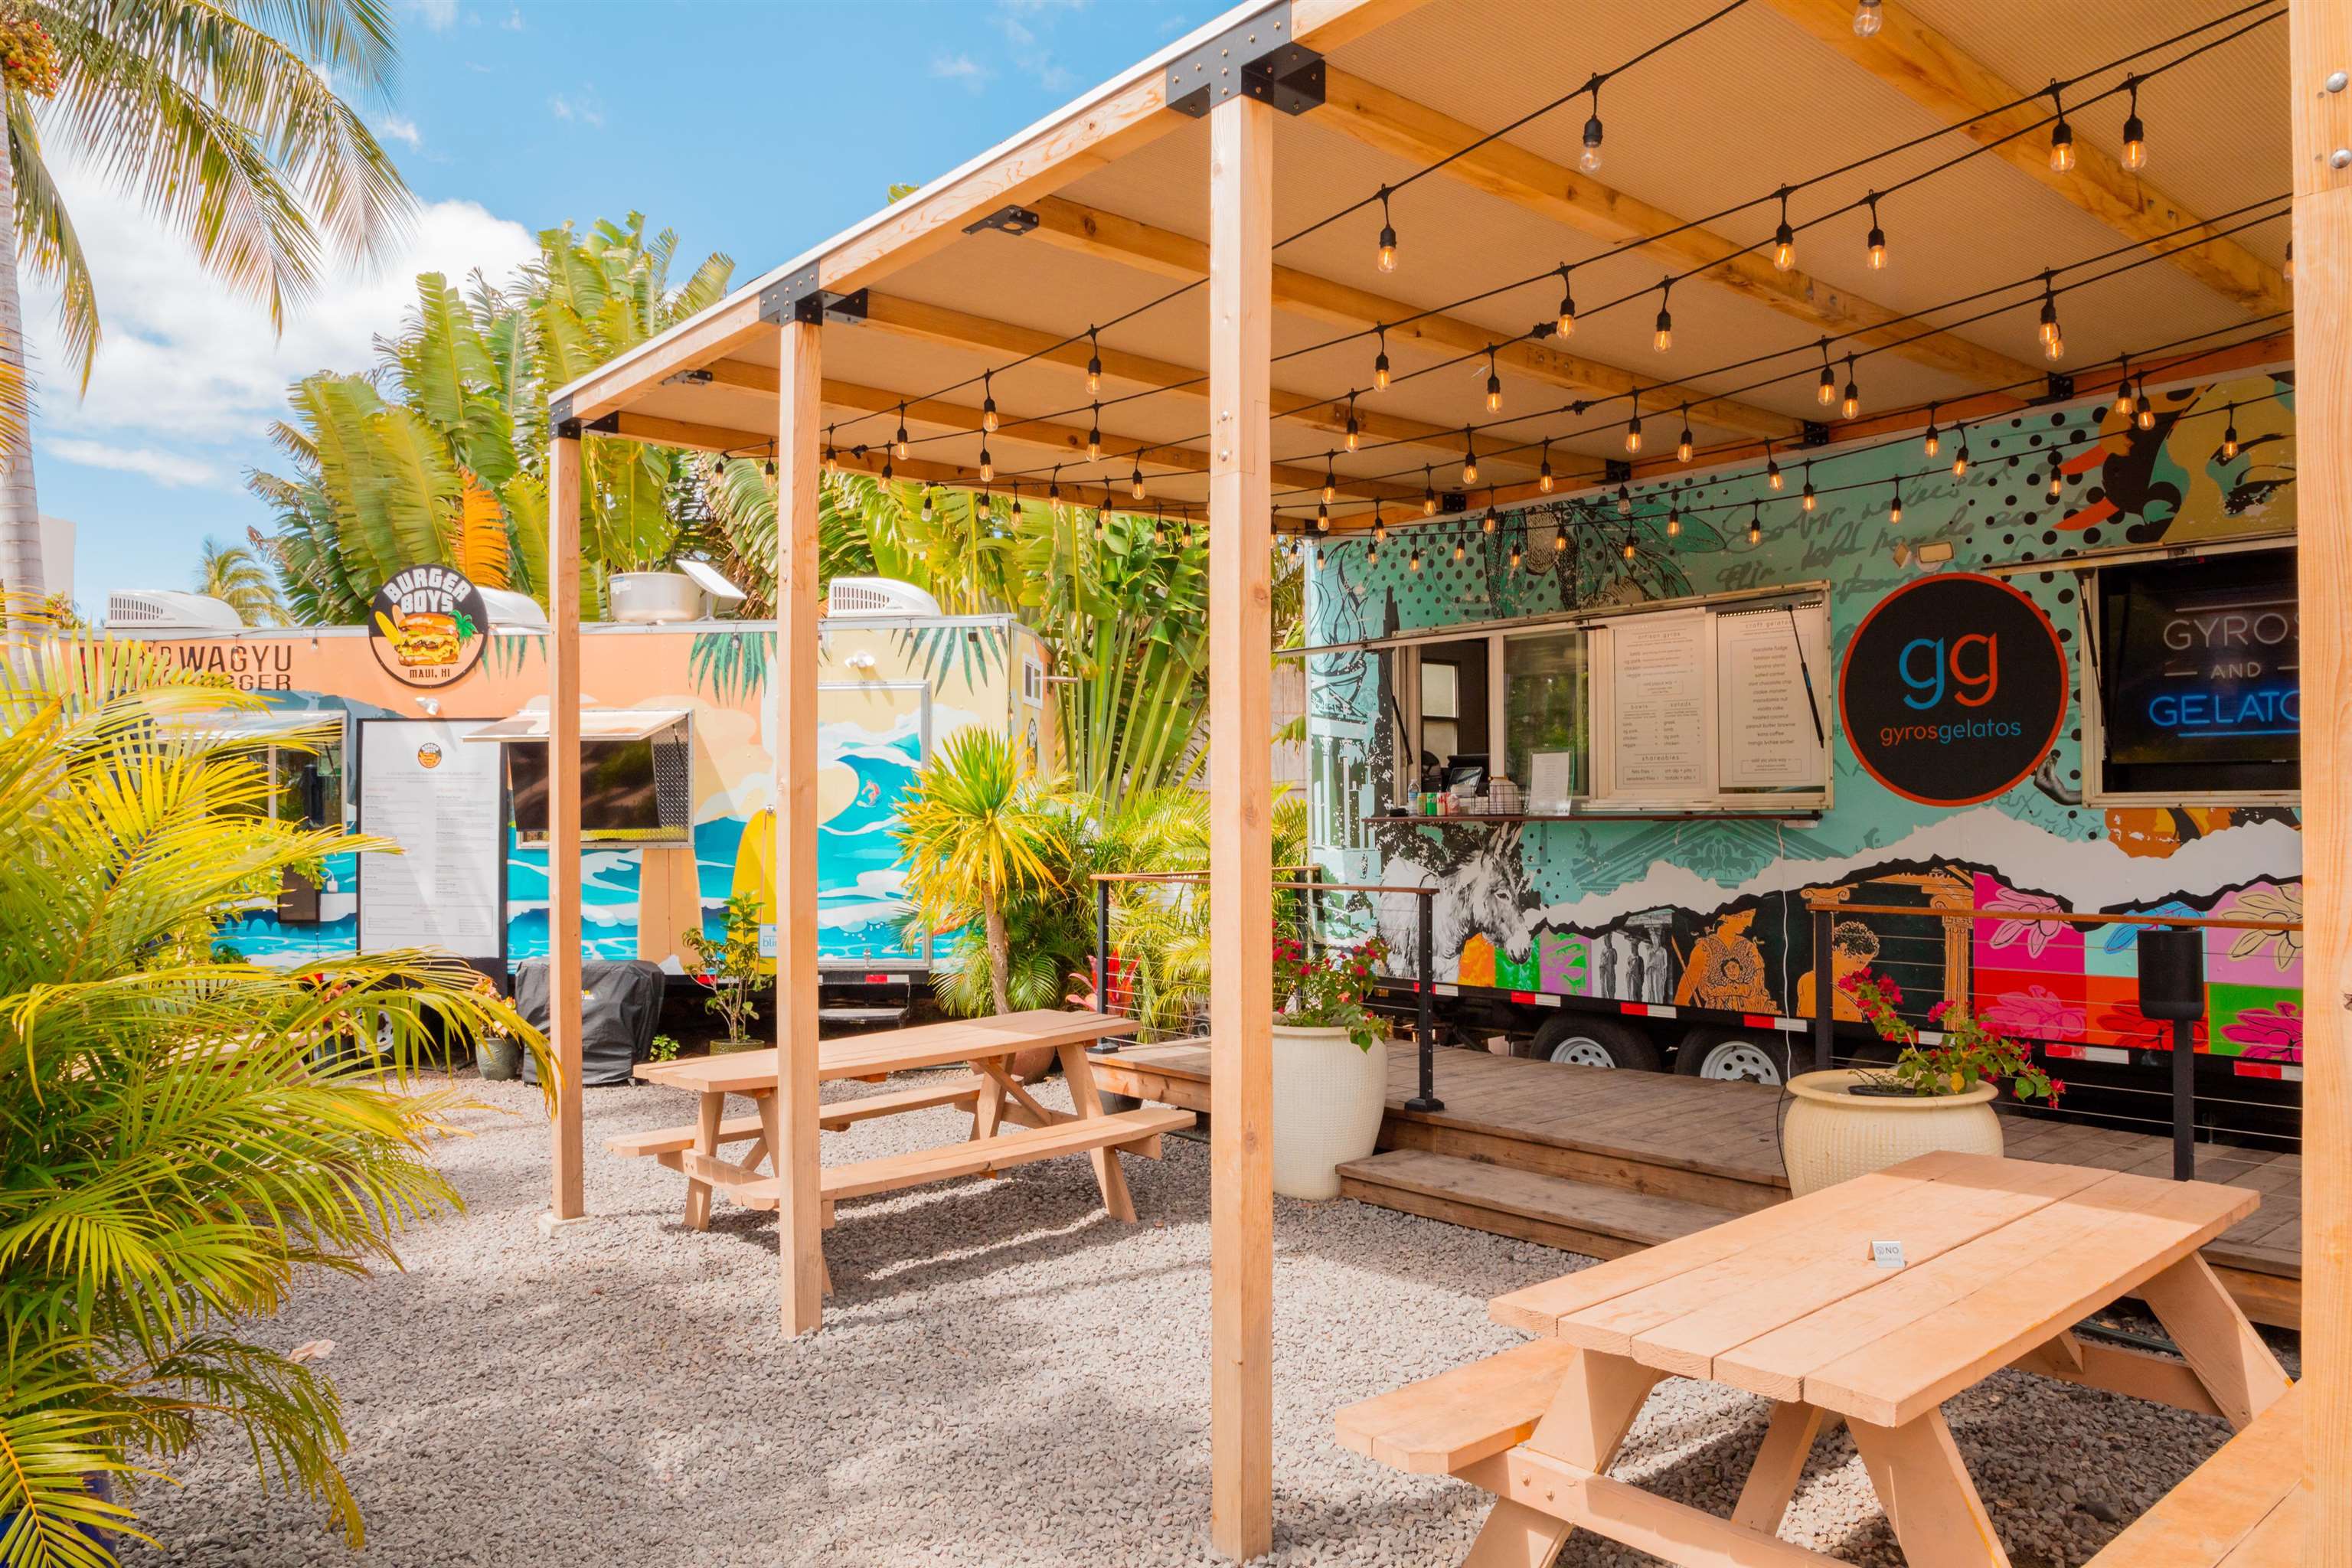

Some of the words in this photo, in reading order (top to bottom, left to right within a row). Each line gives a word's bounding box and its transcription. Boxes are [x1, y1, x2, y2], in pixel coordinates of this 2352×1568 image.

[383, 567, 472, 603] BURGER
[401, 589, 453, 613] BOYS
[179, 645, 291, 672] WAGYU
[1899, 632, 1998, 710] gg
[2210, 662, 2262, 679] AND
[410, 669, 437, 679] MAUI,
[441, 668, 450, 678] HI
[1880, 718, 2022, 747] gyrosgelatos
